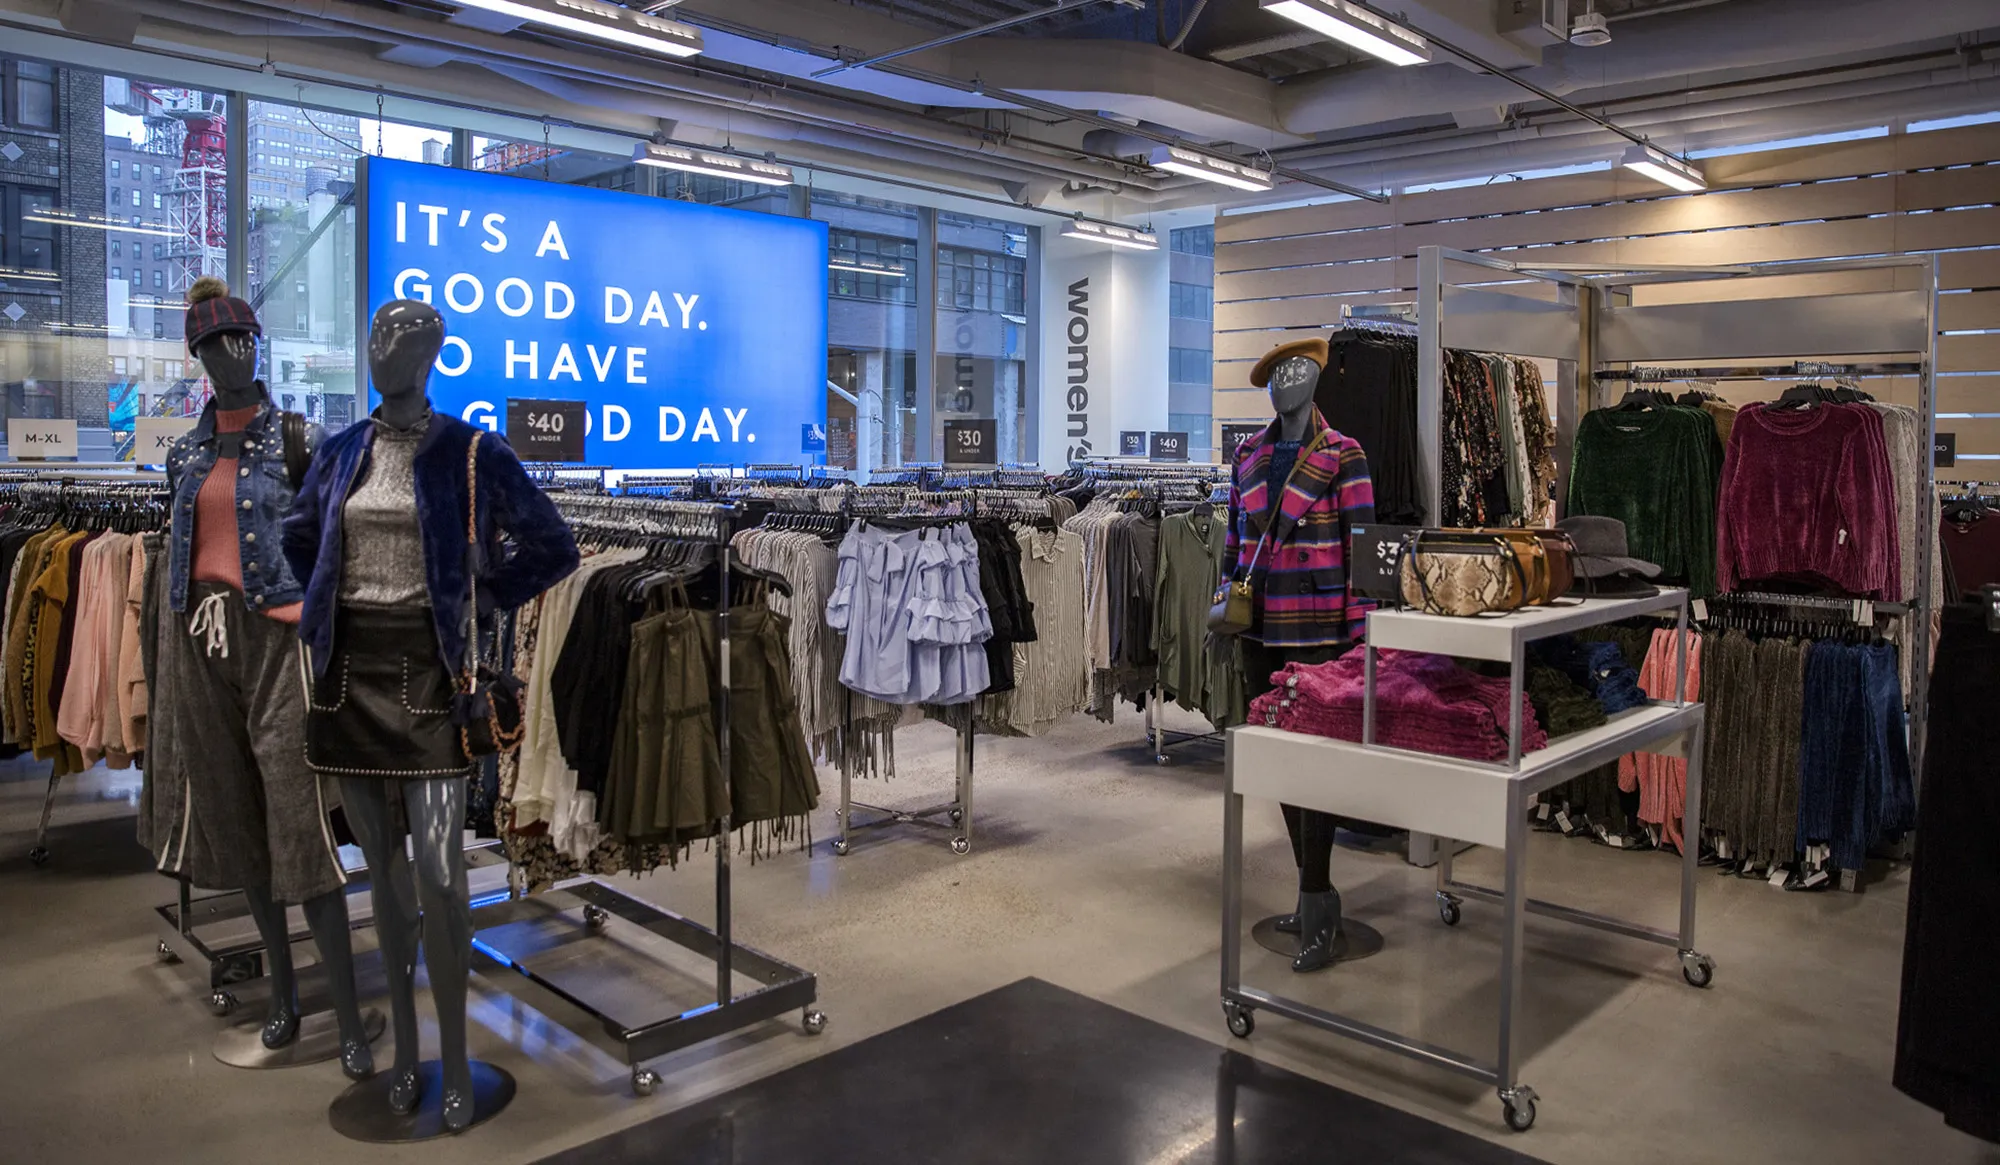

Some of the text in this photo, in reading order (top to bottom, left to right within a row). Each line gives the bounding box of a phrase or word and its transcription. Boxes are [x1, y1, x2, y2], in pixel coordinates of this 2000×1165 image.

[396, 201, 570, 260] IT'S A
[394, 268, 708, 331] GOOD DAY.
[434, 336, 648, 384] O HAVE
[461, 400, 756, 443] GD DAY.
[527, 412, 564, 433] $40
[25, 433, 62, 444] M-XL
[537, 434, 561, 442] UNDER
[957, 430, 981, 446] $30
[1160, 438, 1178, 448] $40
[1376, 540, 1400, 565] $3
